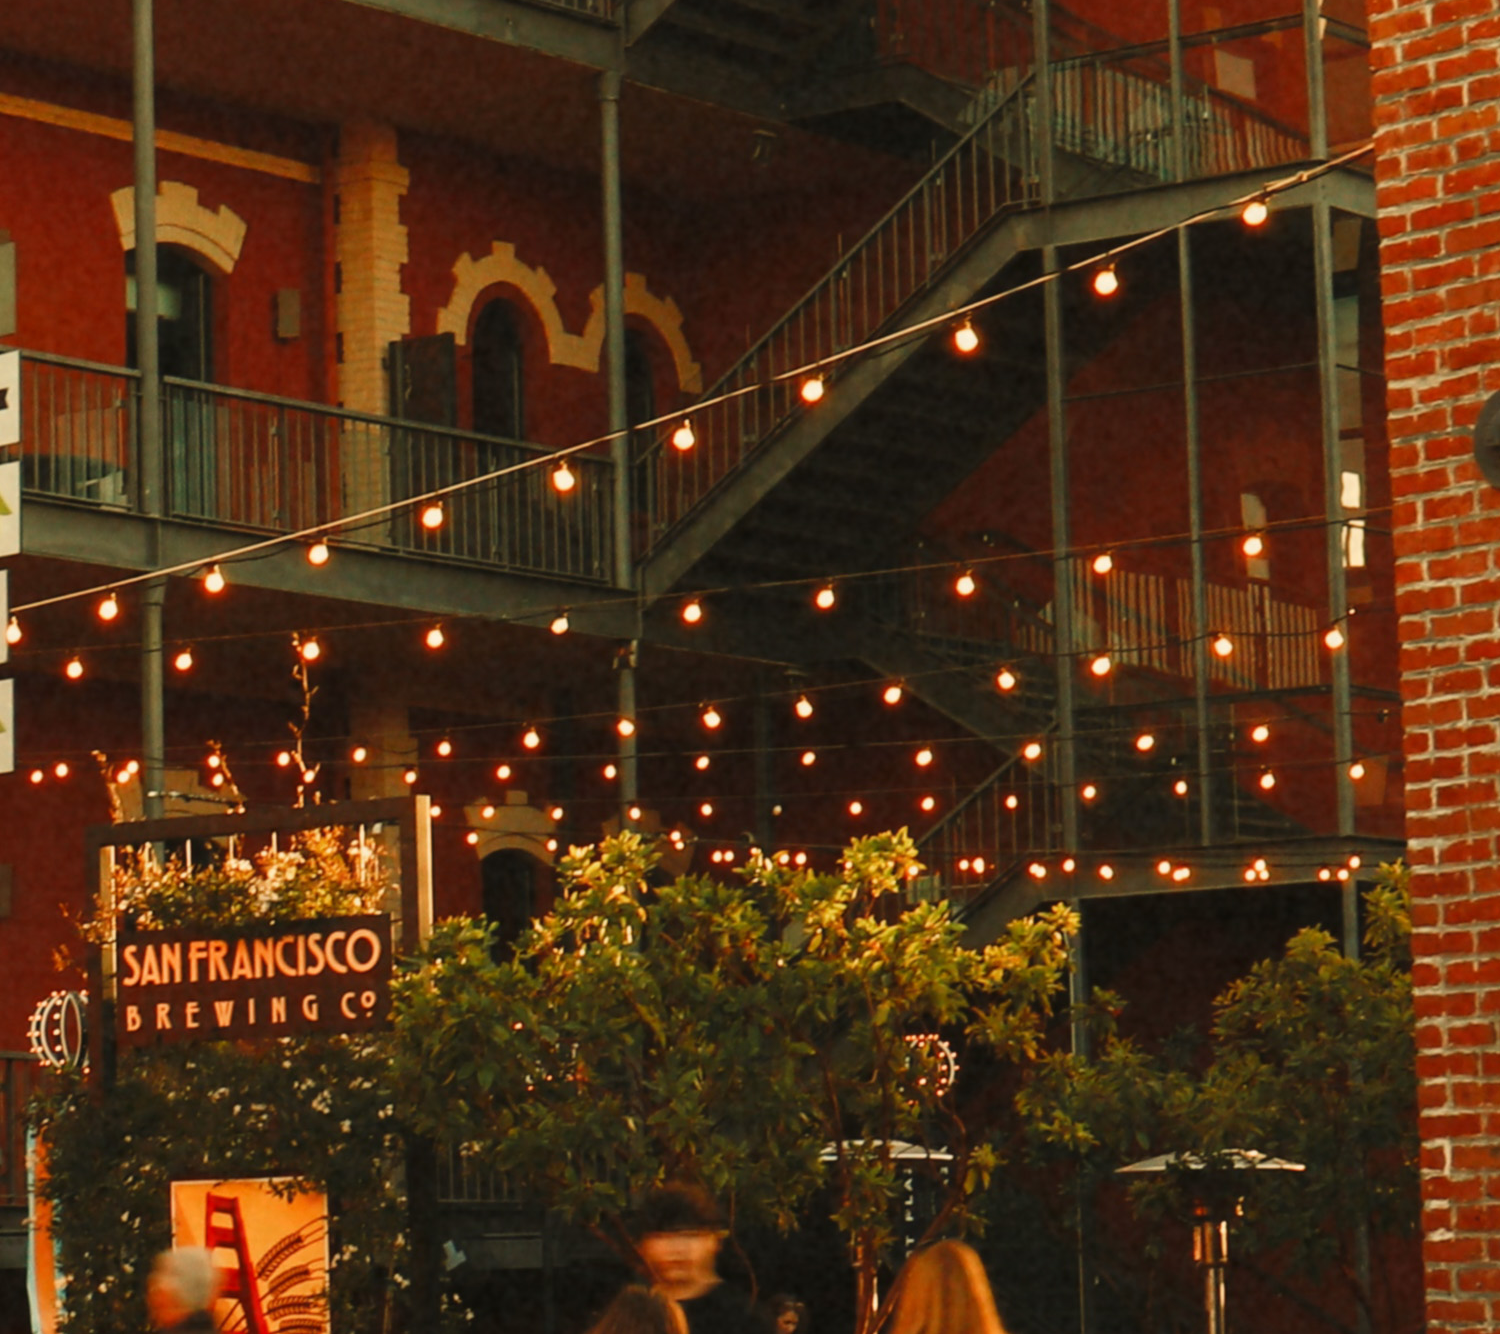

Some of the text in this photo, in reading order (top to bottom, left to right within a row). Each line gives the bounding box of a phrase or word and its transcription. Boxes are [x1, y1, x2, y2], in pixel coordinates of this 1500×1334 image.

[123, 928, 382, 987] SAN FRANCISCO
[126, 994, 319, 1033] BREWING
